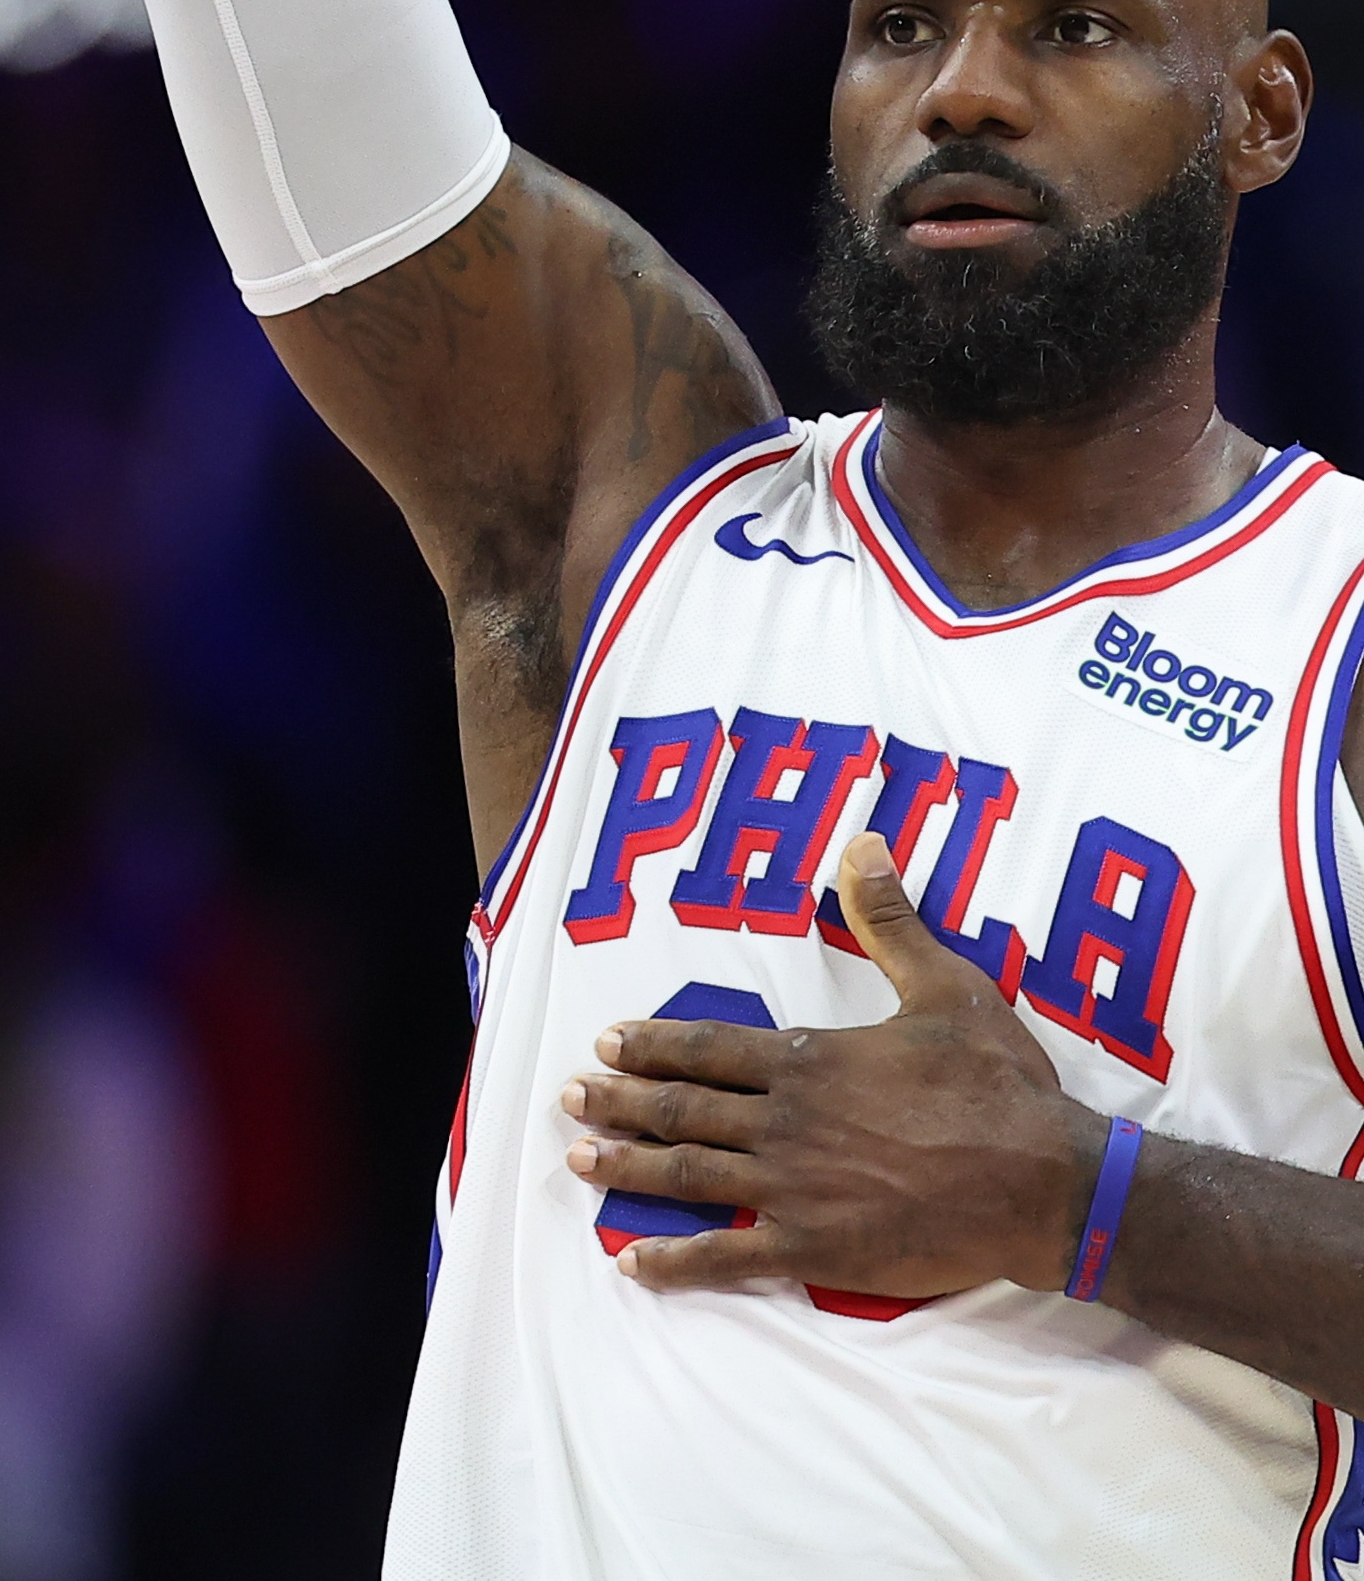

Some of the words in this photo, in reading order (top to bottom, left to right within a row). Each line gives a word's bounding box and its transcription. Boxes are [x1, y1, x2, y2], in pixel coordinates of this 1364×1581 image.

[1078, 659, 1259, 752] energy
[1094, 611, 1274, 722] Bloom
[562, 705, 1196, 1084] PHILA
